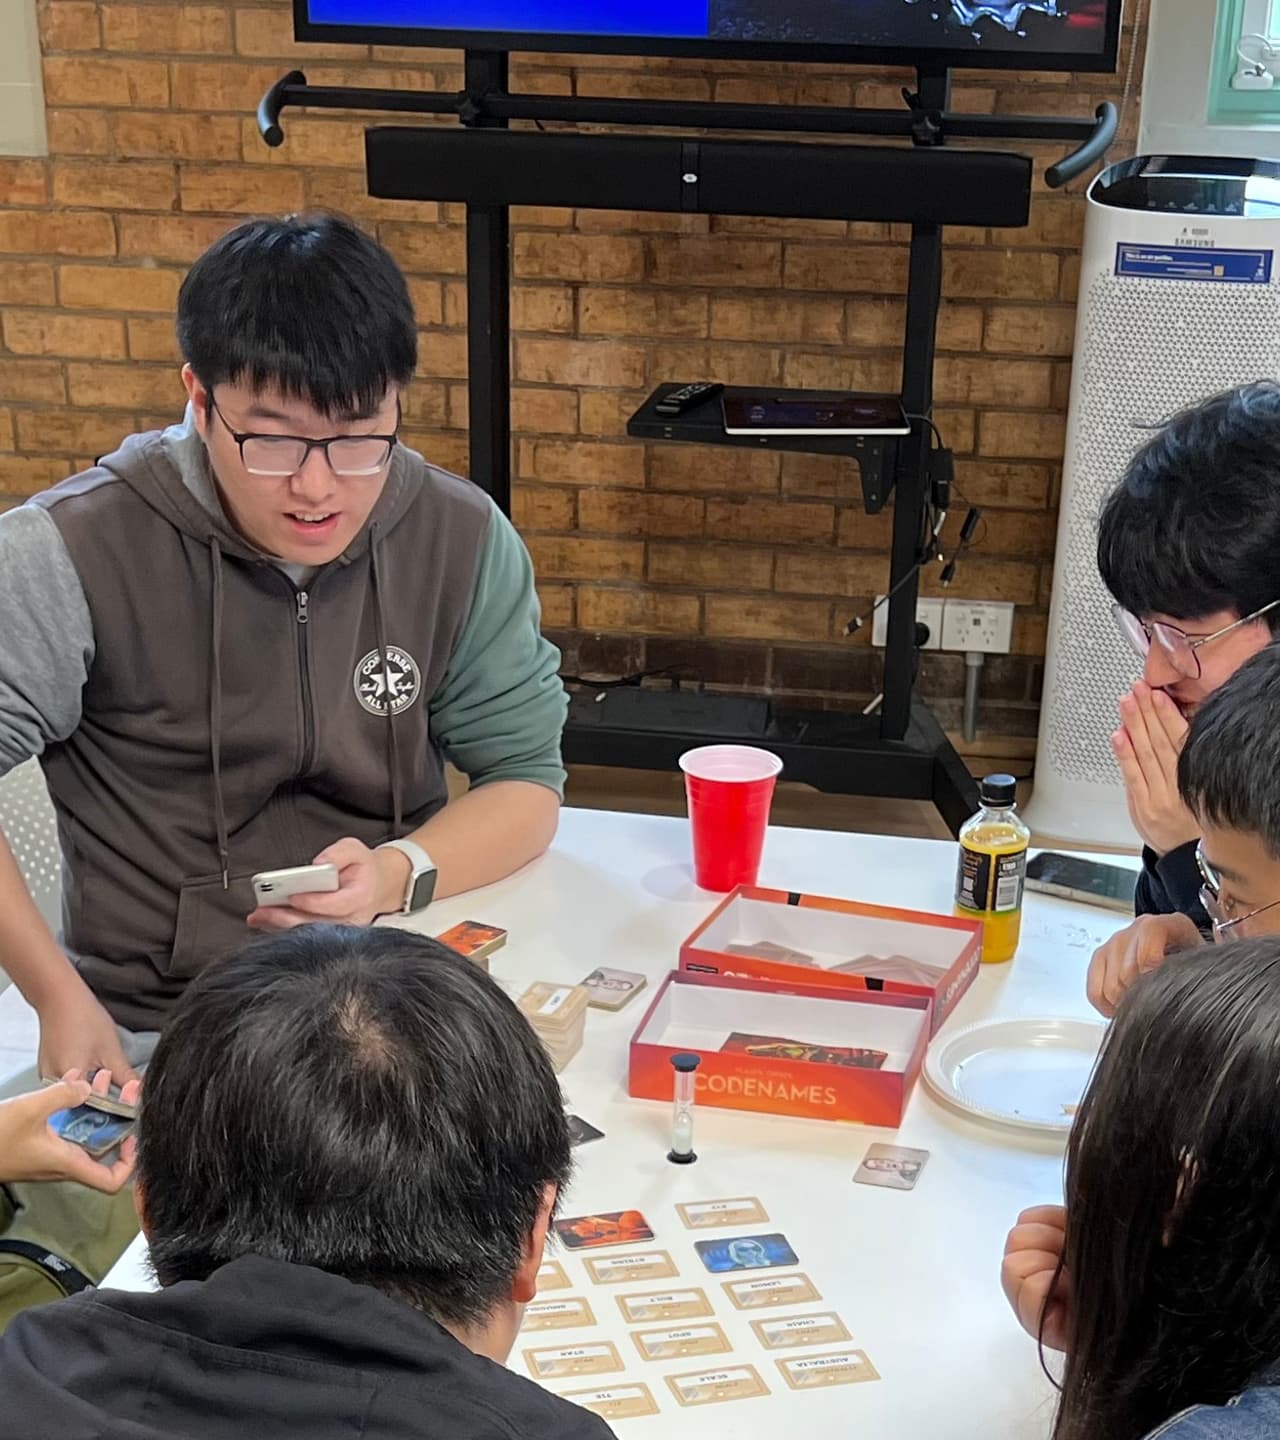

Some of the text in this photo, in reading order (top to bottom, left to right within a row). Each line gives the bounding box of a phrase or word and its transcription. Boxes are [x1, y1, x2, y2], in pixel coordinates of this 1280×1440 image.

[694, 1073, 837, 1105] CODENAMES
[796, 1357, 850, 1369] AUSTRALIA
[699, 1373, 729, 1383] SCALE
